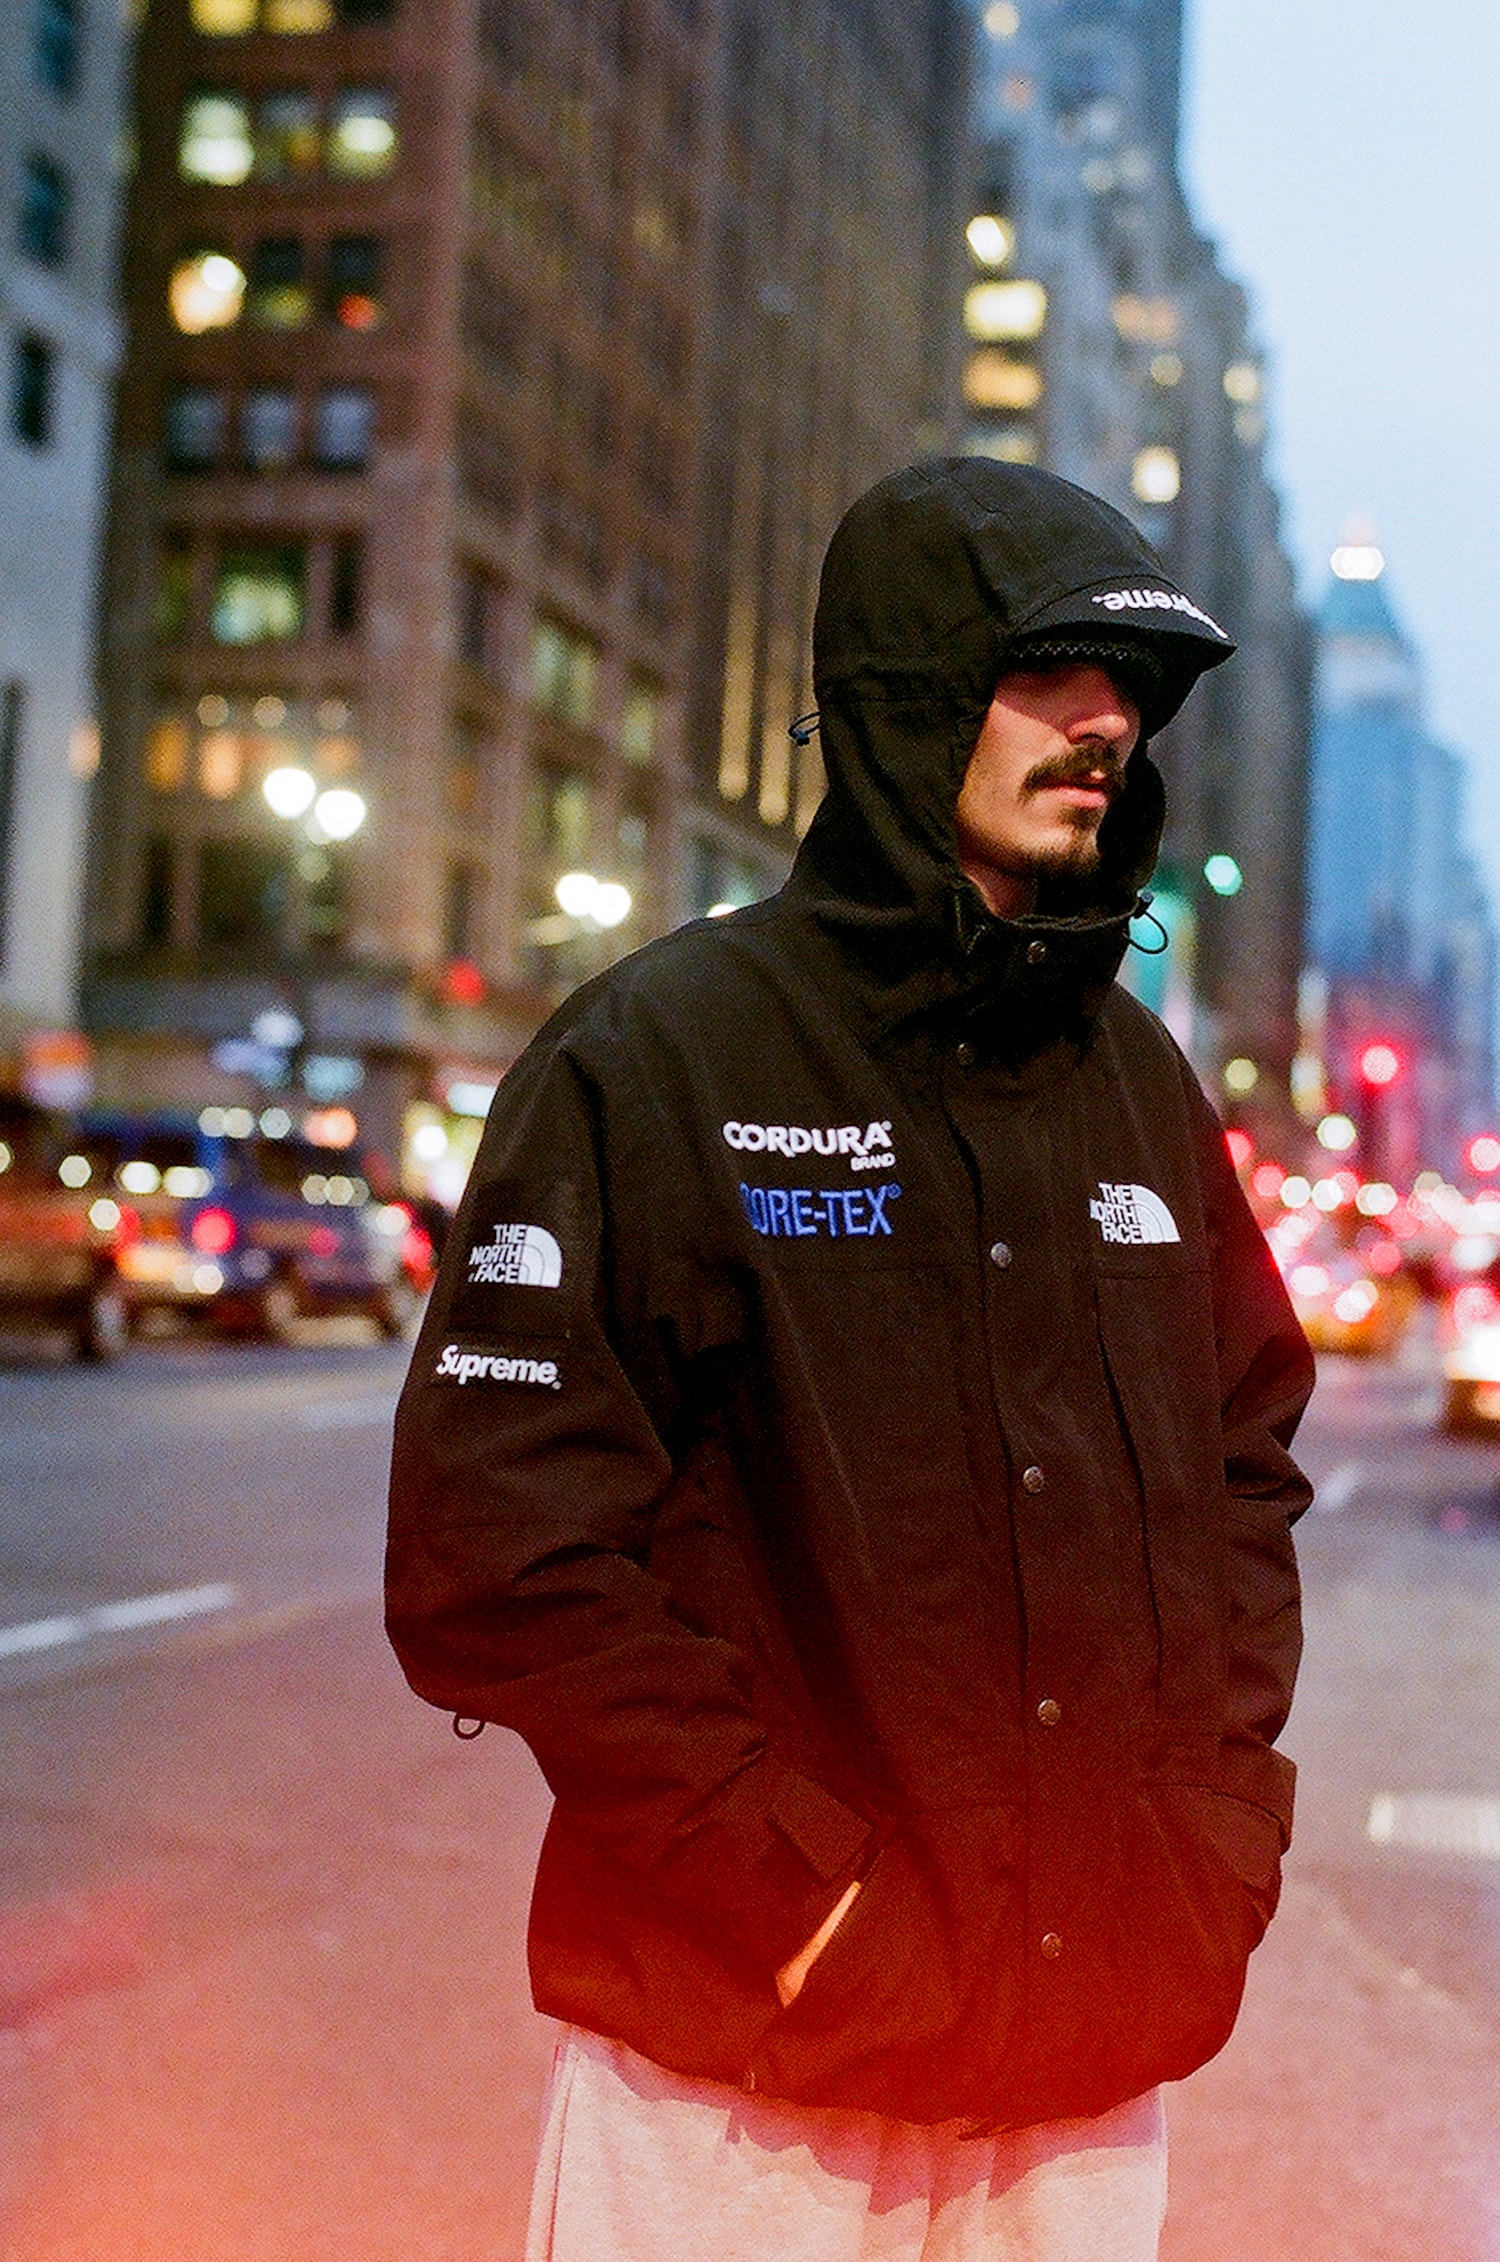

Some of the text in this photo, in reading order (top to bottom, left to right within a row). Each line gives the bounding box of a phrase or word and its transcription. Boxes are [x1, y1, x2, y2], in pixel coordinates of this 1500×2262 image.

[850, 1152, 896, 1171] BRAND
[1098, 1182, 1132, 1205] THE
[493, 1223, 527, 1244] THE
[1101, 1221, 1143, 1245] FACE
[468, 1244, 522, 1266] NORTH
[473, 1263, 520, 1285] FACE
